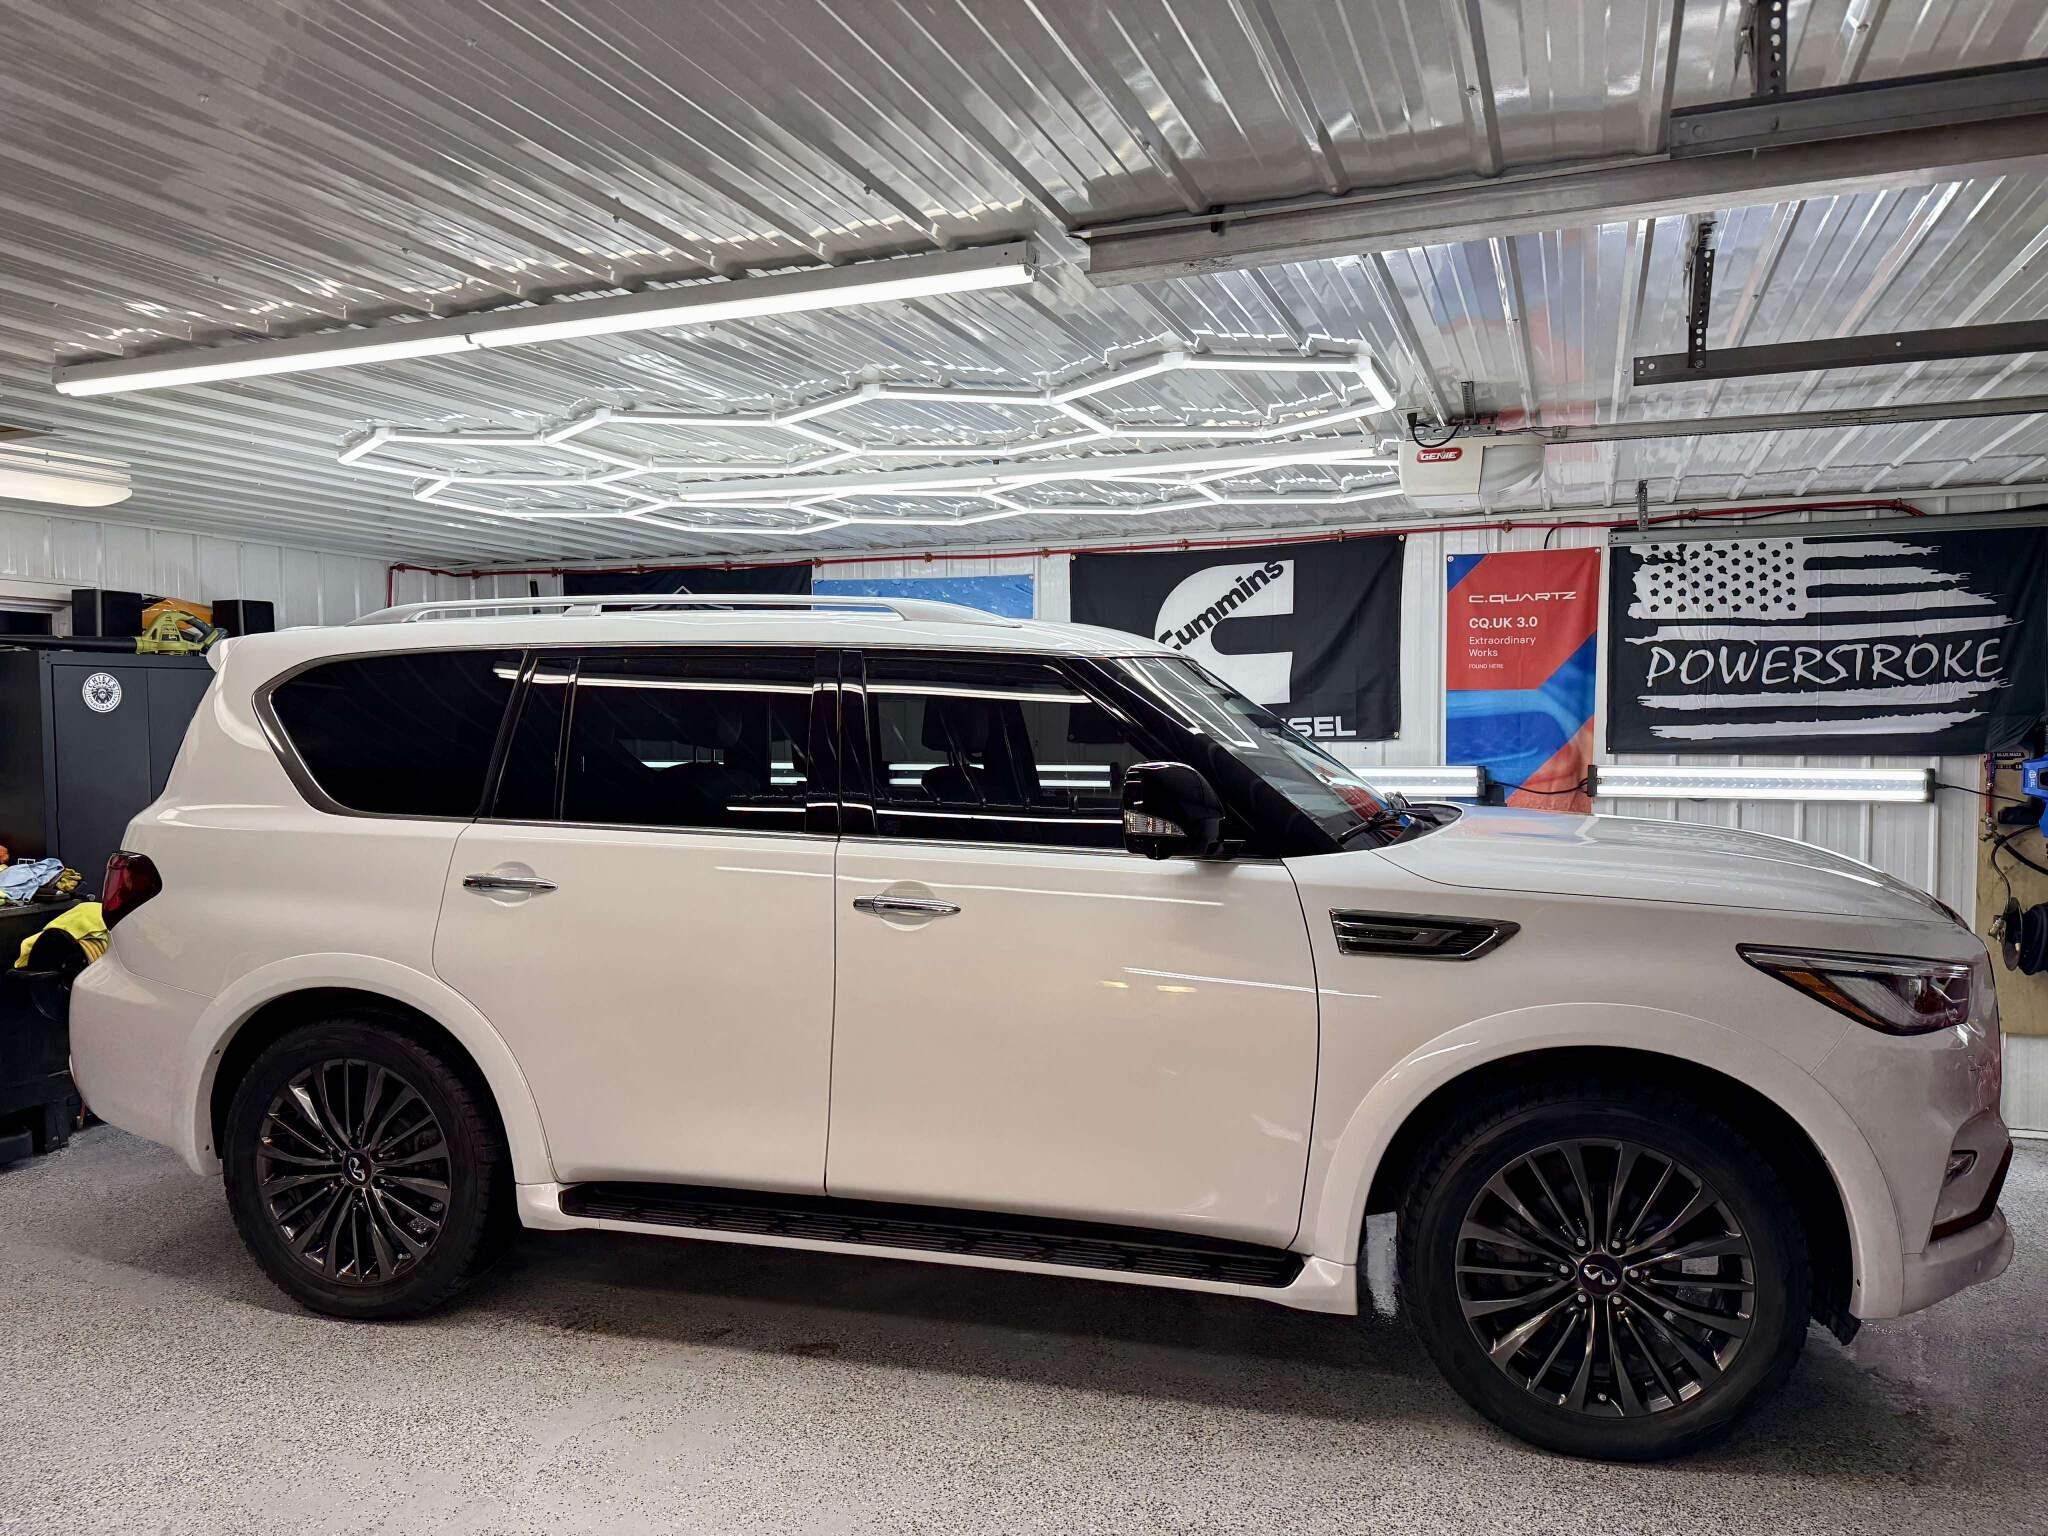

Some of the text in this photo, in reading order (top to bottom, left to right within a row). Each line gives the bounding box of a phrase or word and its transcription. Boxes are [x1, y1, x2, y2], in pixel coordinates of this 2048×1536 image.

[1420, 451, 1459, 461] GENIE
[1468, 591, 1577, 605] C.QUARTZ
[1158, 559, 1284, 651] Cummins
[1468, 616, 1538, 629] CQ.UK 3.0
[1469, 636, 1536, 645] Extraordinary
[1468, 648, 1498, 657] Works
[1646, 638, 2004, 687] POWERSTROKE
[1281, 715, 1356, 737] SEL
